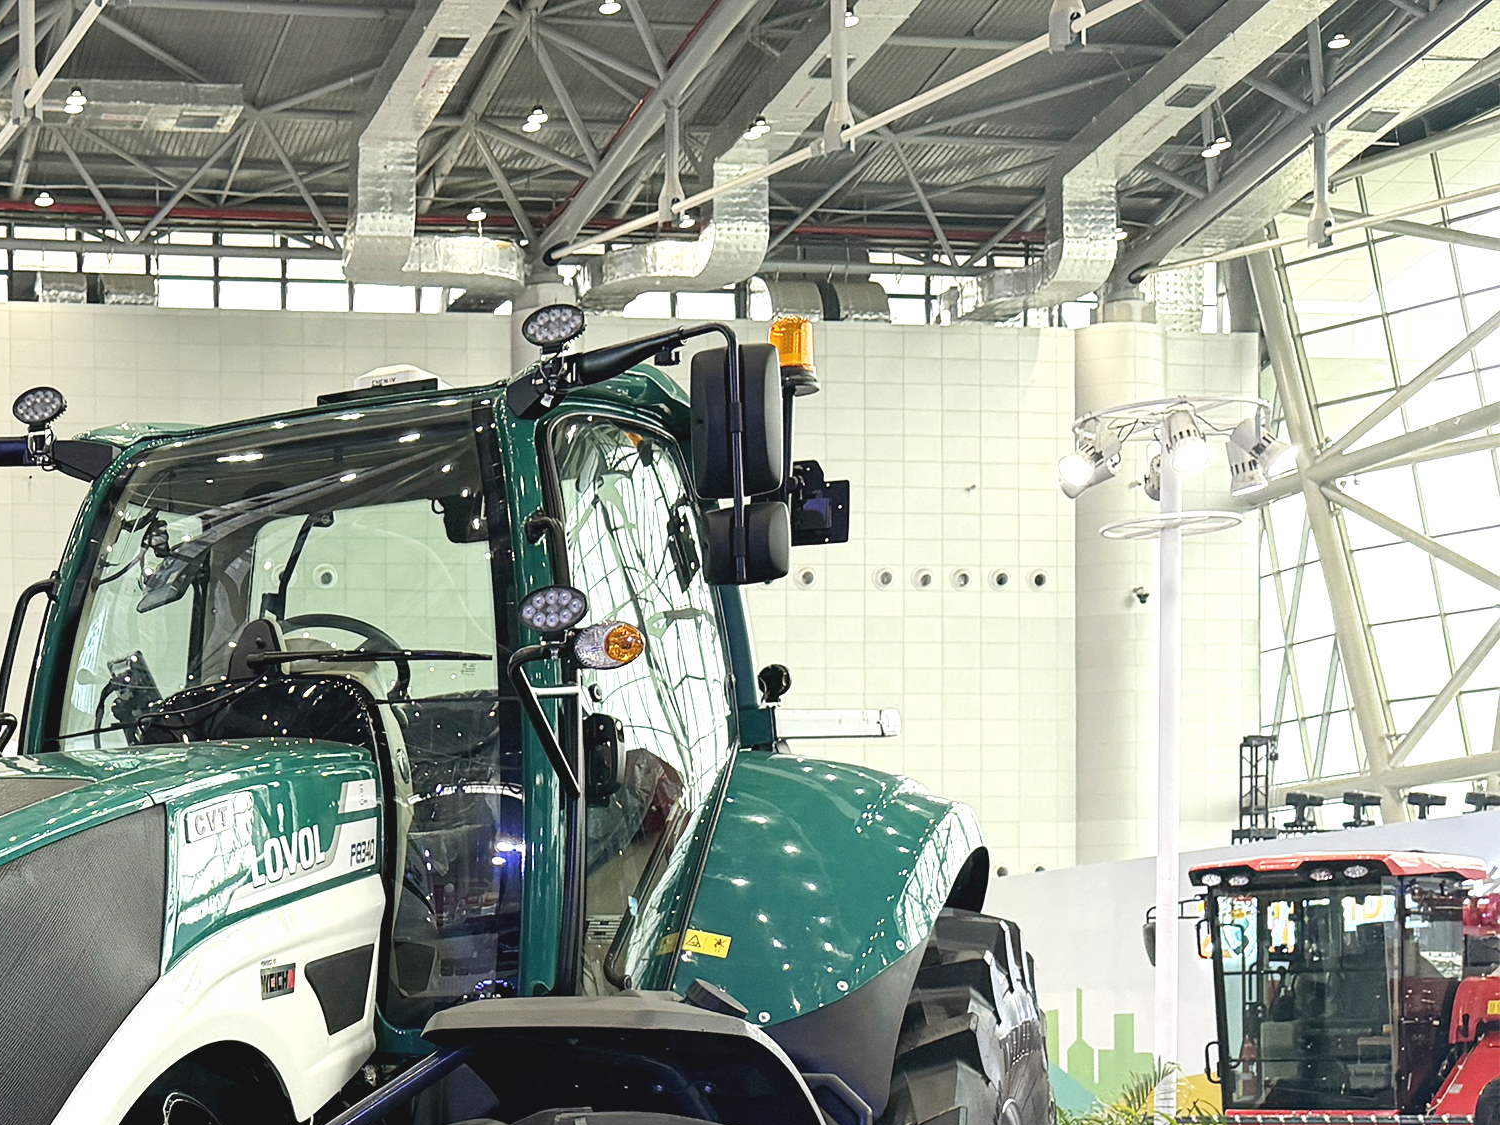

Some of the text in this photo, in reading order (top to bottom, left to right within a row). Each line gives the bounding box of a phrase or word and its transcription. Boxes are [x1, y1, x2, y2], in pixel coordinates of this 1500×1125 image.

[194, 806, 228, 836] CVT
[251, 824, 327, 888] LOVOL
[350, 838, 375, 867] P8340
